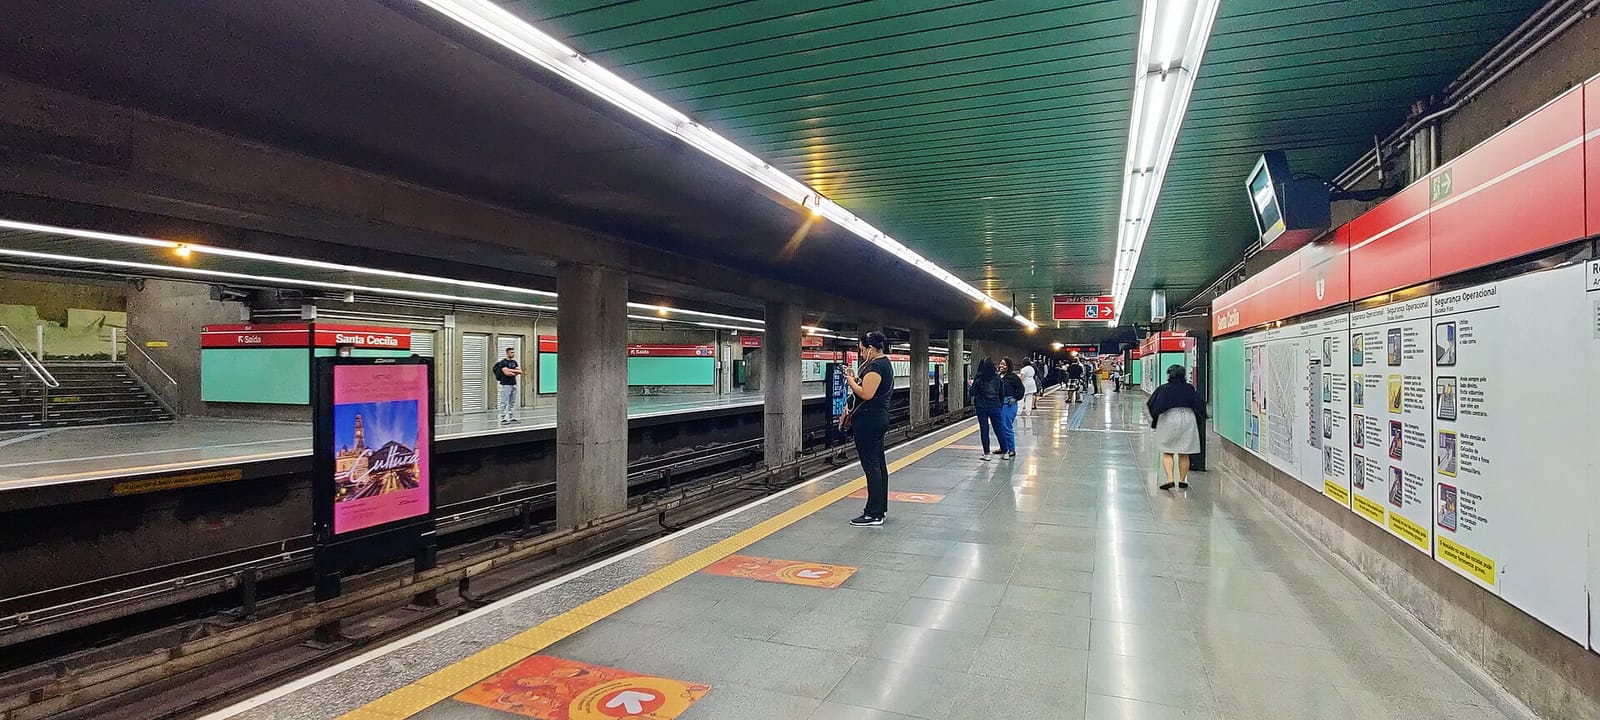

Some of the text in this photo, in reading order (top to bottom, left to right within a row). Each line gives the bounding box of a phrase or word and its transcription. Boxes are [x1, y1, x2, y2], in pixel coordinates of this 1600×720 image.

[1434, 285, 1497, 307] Segurança Operacional
[336, 333, 364, 344] Santa
[338, 445, 420, 484] Cultura
